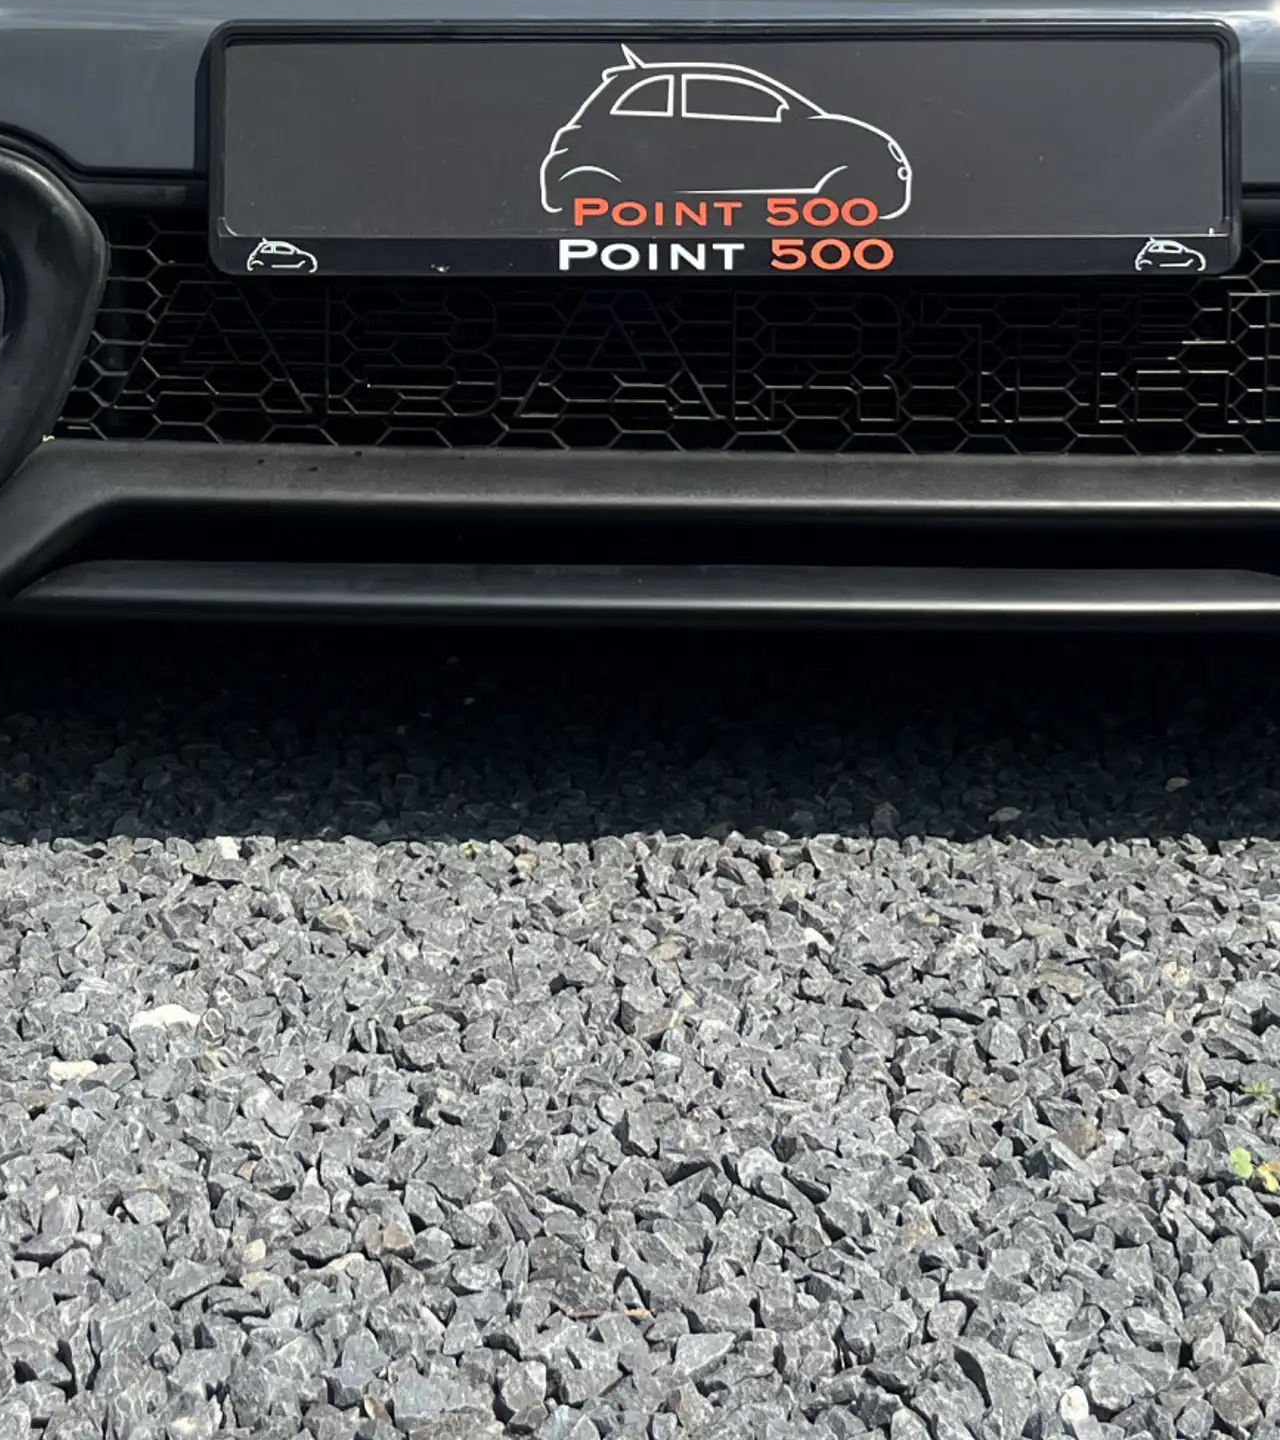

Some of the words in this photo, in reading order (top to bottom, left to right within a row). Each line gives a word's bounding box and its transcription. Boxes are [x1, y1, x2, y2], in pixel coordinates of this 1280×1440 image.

[573, 197, 743, 227] POINT
[765, 196, 880, 227] 500
[558, 238, 745, 272] POINT
[769, 237, 894, 272] 500
